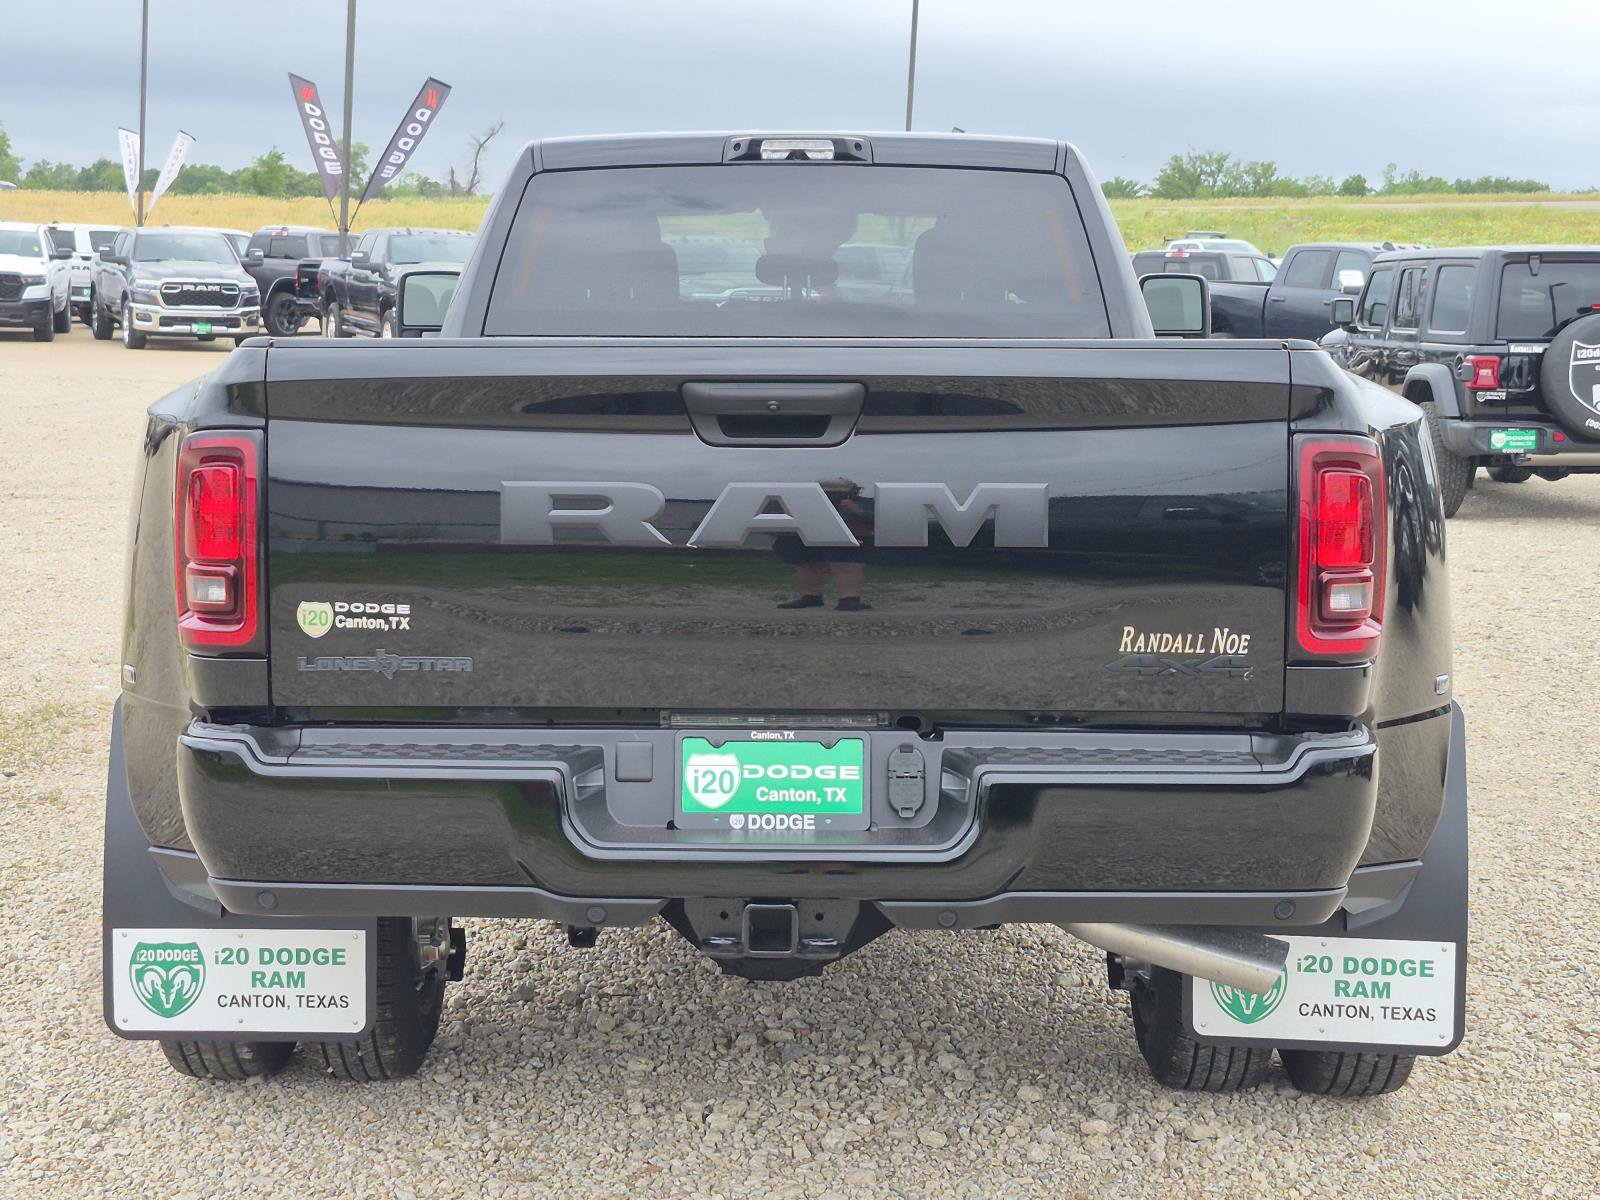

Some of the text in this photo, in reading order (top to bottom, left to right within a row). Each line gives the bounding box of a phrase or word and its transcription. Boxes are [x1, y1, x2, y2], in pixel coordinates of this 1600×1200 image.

[304, 102, 342, 174] DODGE
[183, 284, 220, 292] RAM
[501, 480, 1049, 548] RAM
[302, 601, 411, 626] i20 DODGE
[1119, 626, 1251, 655] RANDALL NOE
[297, 656, 474, 672] LONE STAR
[750, 731, 795, 740] Canton, TX
[693, 764, 860, 794] i20 DODGE
[756, 786, 847, 804] Canton, TX
[748, 814, 815, 829] DODGE
[136, 949, 199, 962] i20 DODGE
[214, 947, 346, 966] i20 DODGE
[1297, 955, 1434, 978] i20 DODGE
[251, 971, 305, 989] RAM
[1334, 980, 1391, 1000] RAM
[217, 994, 349, 1010] CANTON, TEXAS
[1298, 1003, 1436, 1022] CANTON, TEXAS
